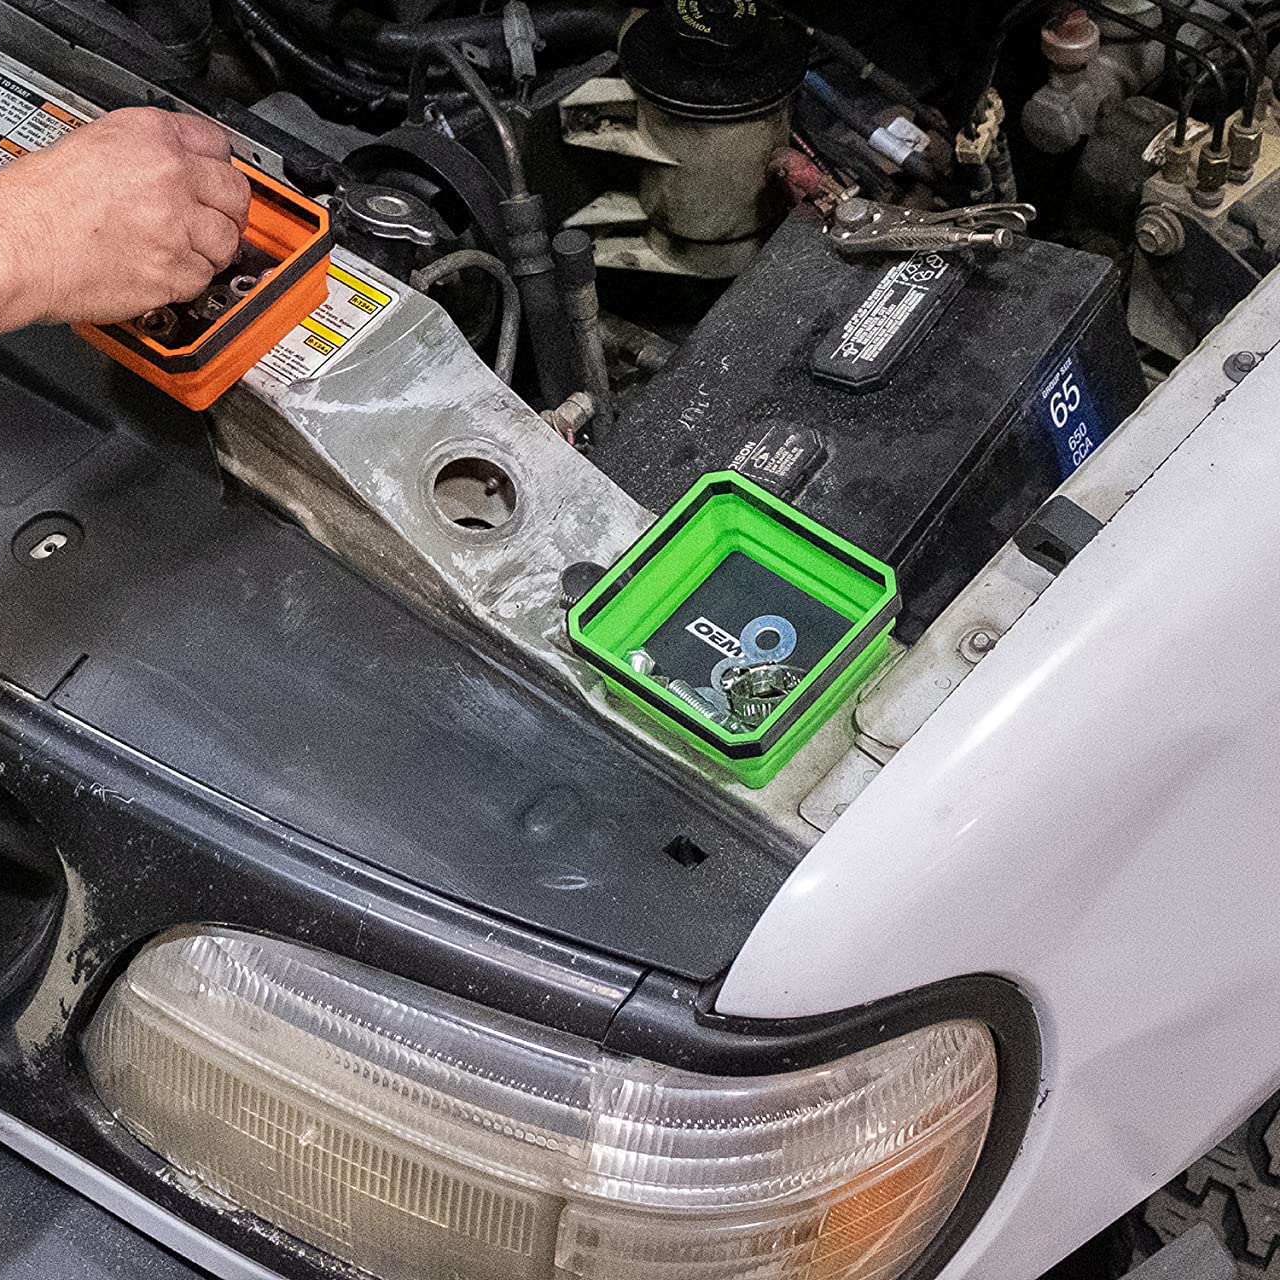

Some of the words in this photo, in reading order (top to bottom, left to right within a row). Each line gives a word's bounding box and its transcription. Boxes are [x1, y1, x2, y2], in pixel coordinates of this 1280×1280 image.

[681, 14, 711, 33] POWER
[0, 79, 12, 87] TO
[7, 83, 31, 99] START
[45, 116, 59, 126] NOT
[352, 297, 374, 312] R-134a
[307, 338, 329, 353] R-134a
[1042, 372, 1060, 399] GROUP
[1060, 357, 1072, 376] SIZE
[1050, 373, 1080, 428] 65
[1068, 422, 1087, 451] 650
[1072, 437, 1093, 466] CCA
[694, 622, 743, 657] OEM
